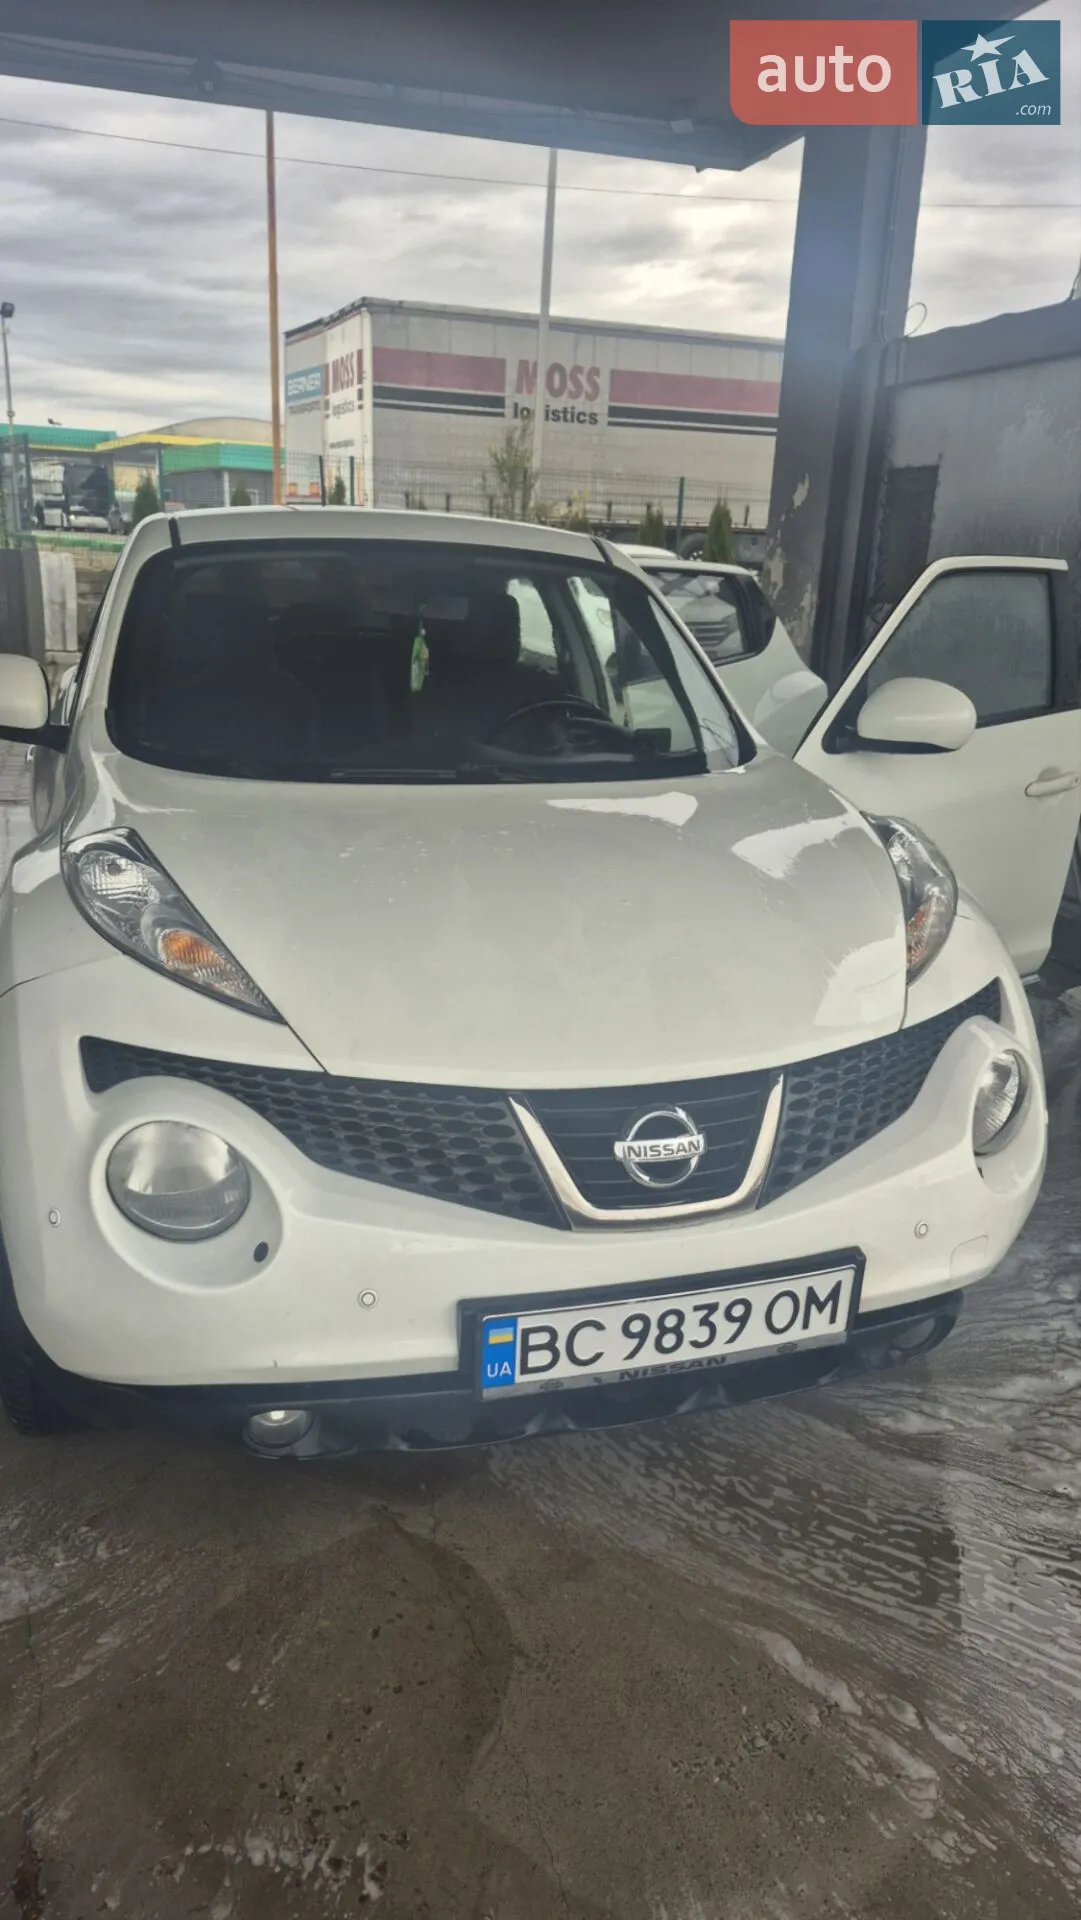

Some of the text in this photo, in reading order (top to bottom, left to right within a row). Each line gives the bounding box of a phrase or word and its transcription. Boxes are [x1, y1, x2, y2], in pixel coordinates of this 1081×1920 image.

[513, 402, 599, 425] loistics
[624, 1138, 702, 1159] NISSAN
[518, 1279, 843, 1377] BC 9839 OM
[486, 1361, 513, 1379] UA
[618, 1355, 728, 1380] NISSAN
